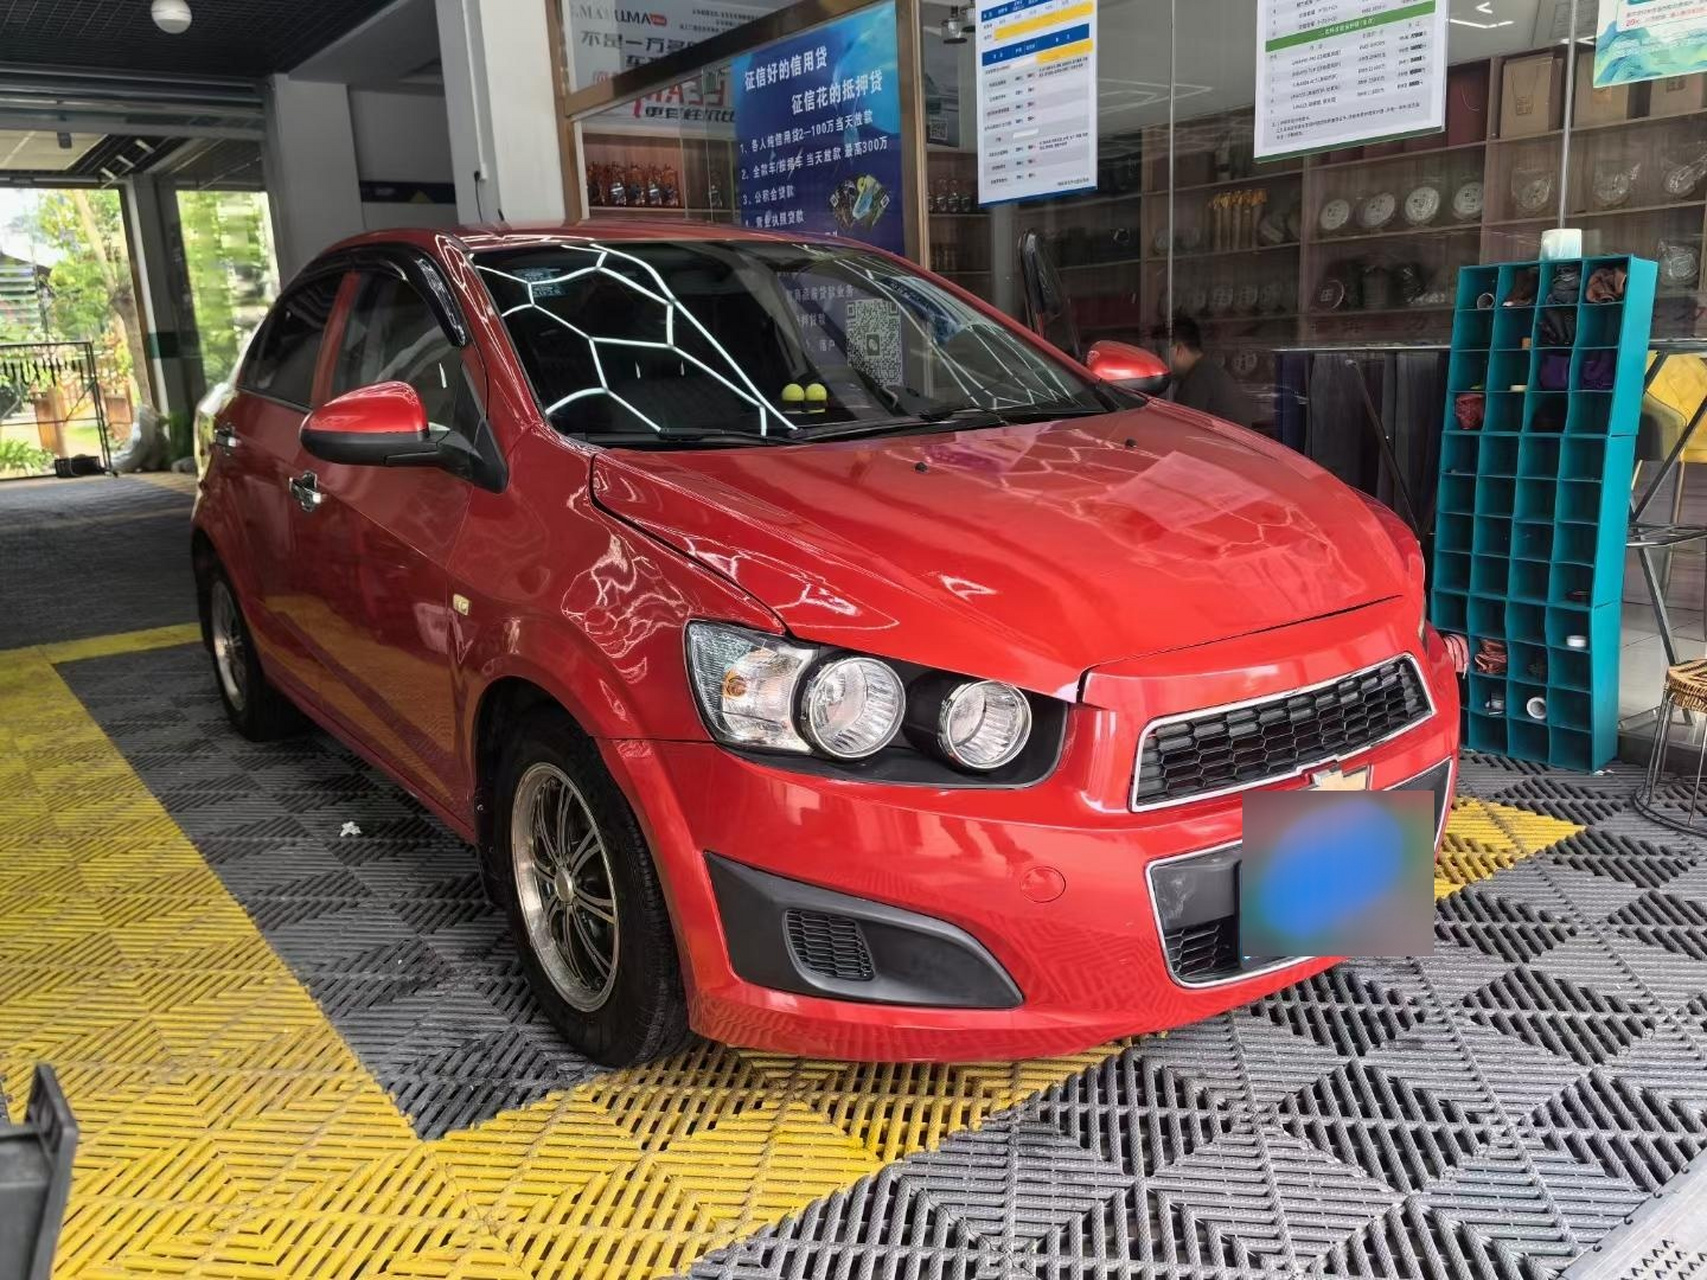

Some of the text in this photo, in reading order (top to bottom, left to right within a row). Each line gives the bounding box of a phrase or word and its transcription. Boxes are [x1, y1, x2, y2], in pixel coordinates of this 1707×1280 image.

[745, 46, 828, 91] 征信好的信用贷
[792, 69, 883, 115] 征信花的抵押贷
